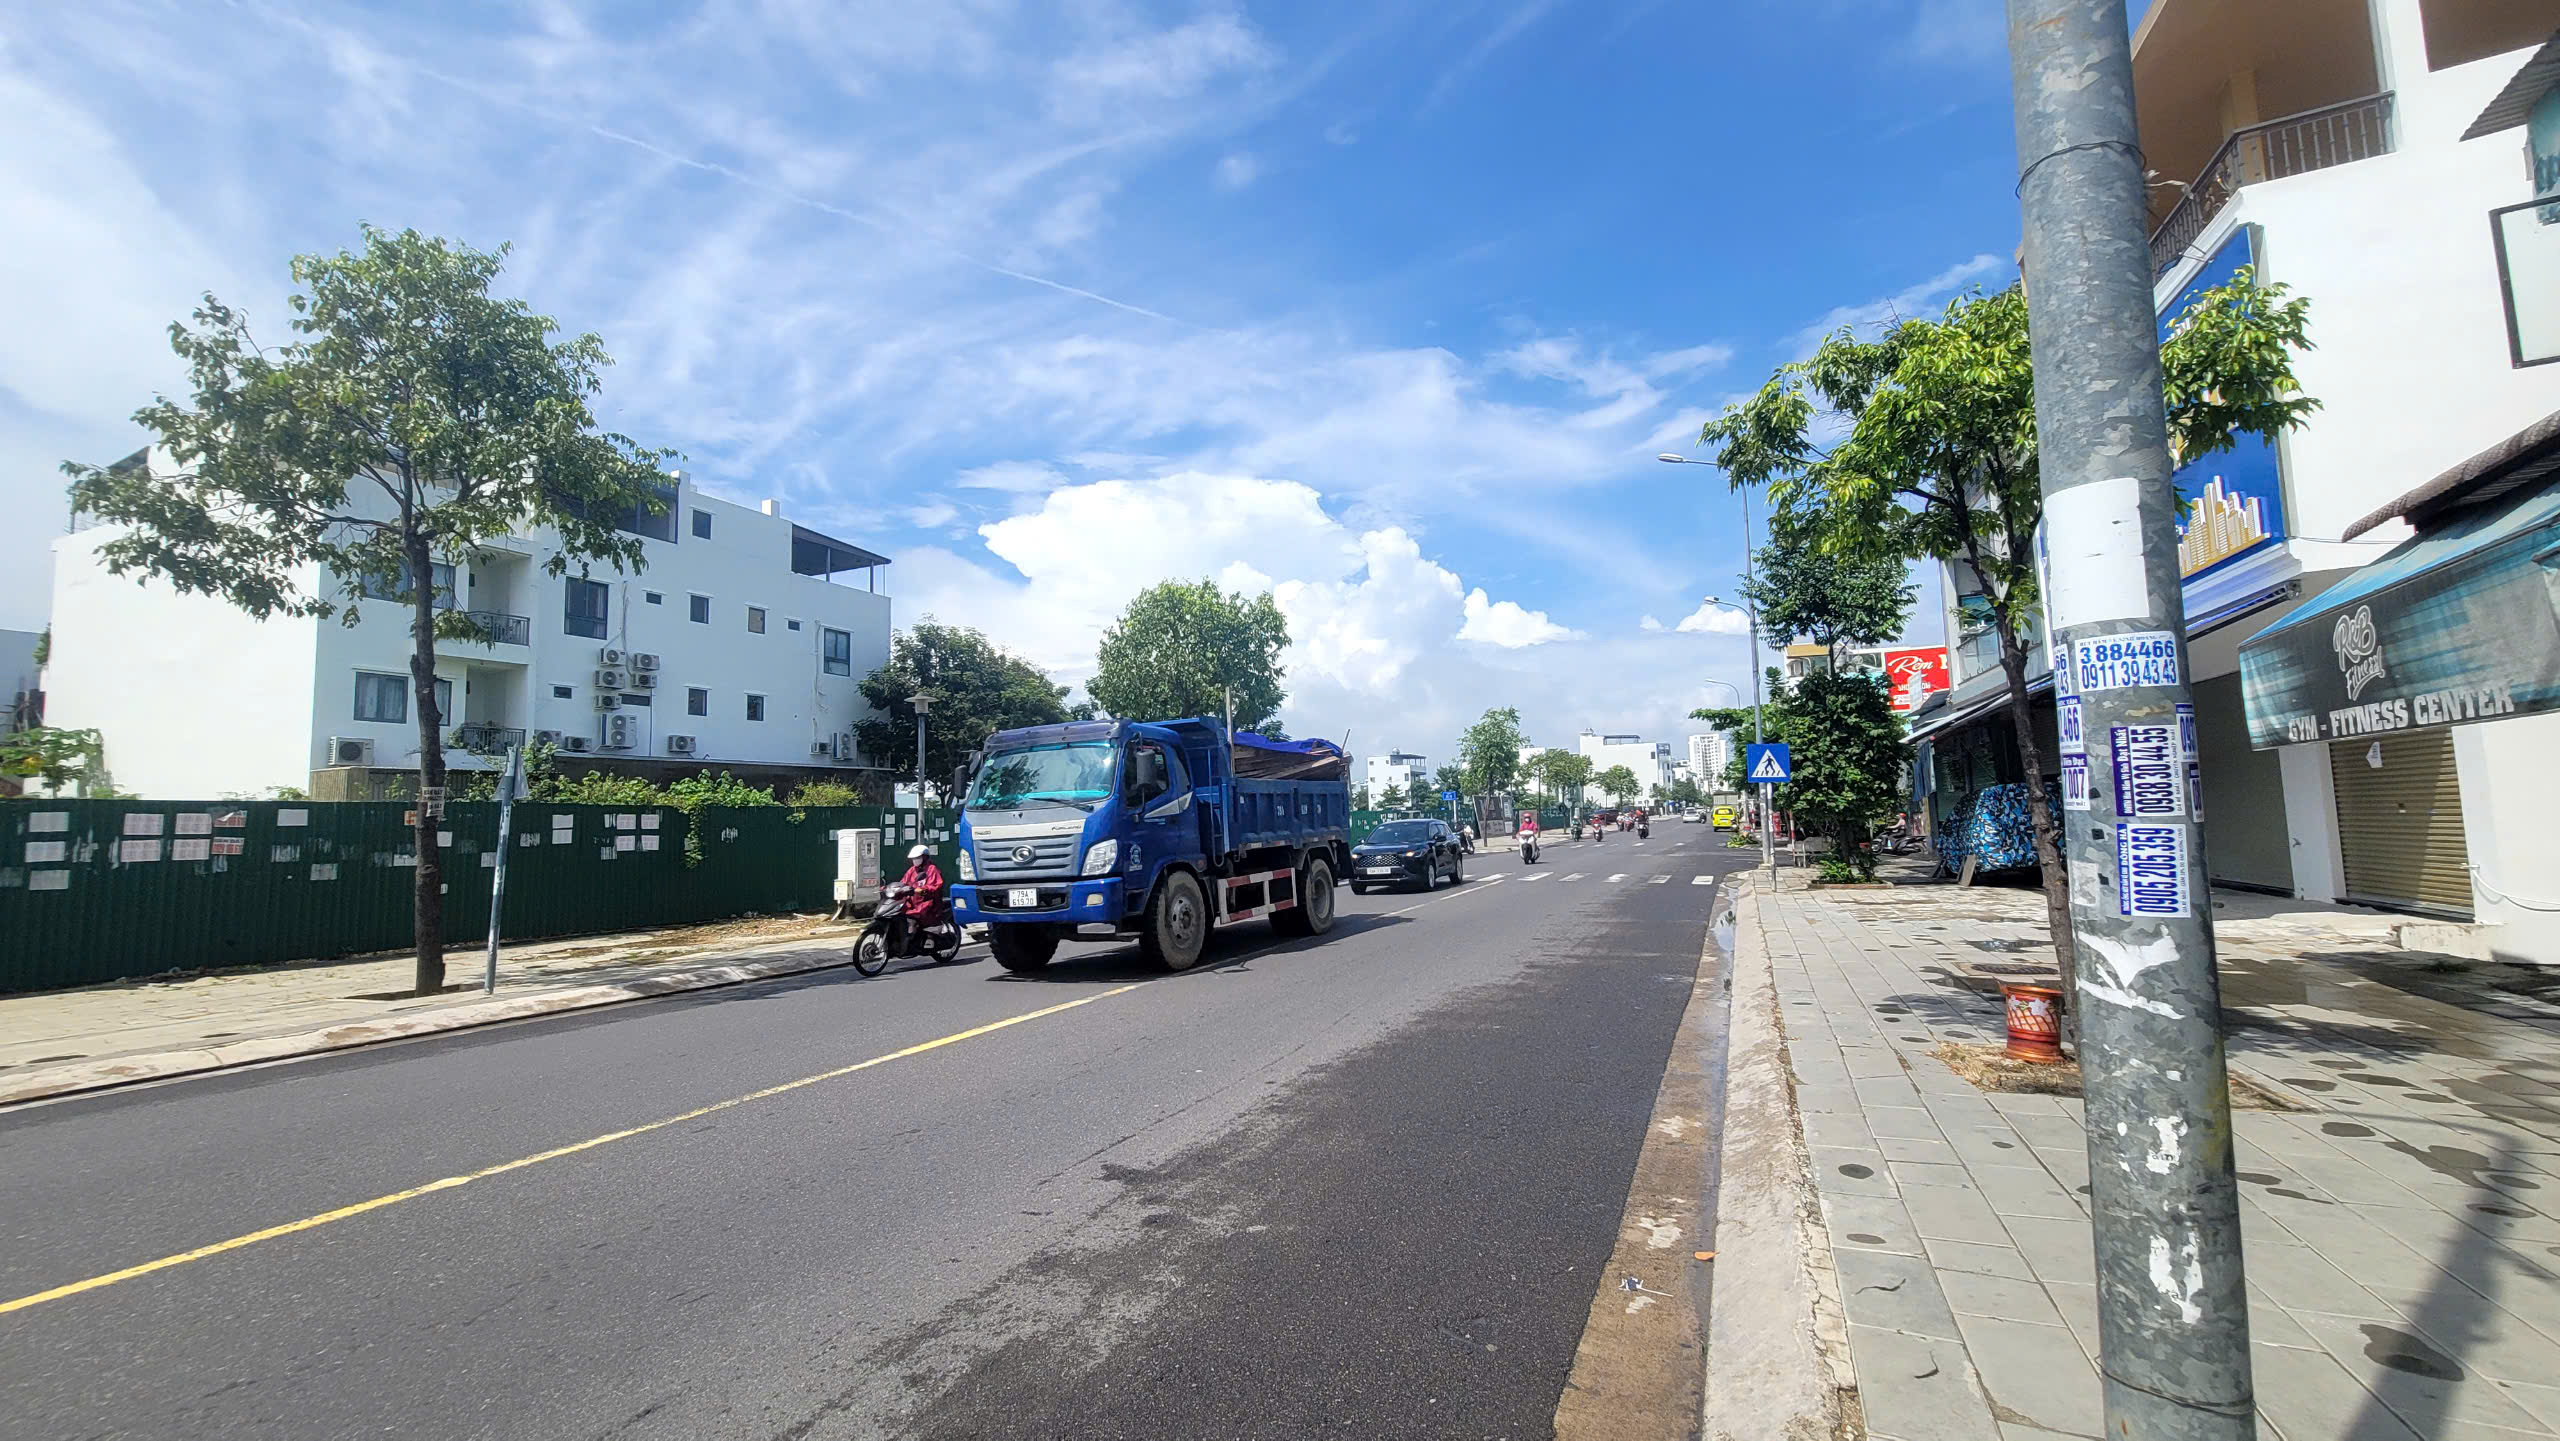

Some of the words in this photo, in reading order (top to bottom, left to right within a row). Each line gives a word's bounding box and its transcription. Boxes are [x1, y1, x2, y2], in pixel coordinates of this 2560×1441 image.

[2081, 658, 2177, 689] 0911.39.43.43
[2114, 728, 2128, 747] Nhất
[2288, 714, 2319, 742] GYM
[2329, 698, 2408, 737] FITNESS
[2413, 684, 2515, 725] CENTER
[2130, 728, 2174, 813] 0938.30.44.55
[2130, 828, 2178, 913] 0905.205.359
